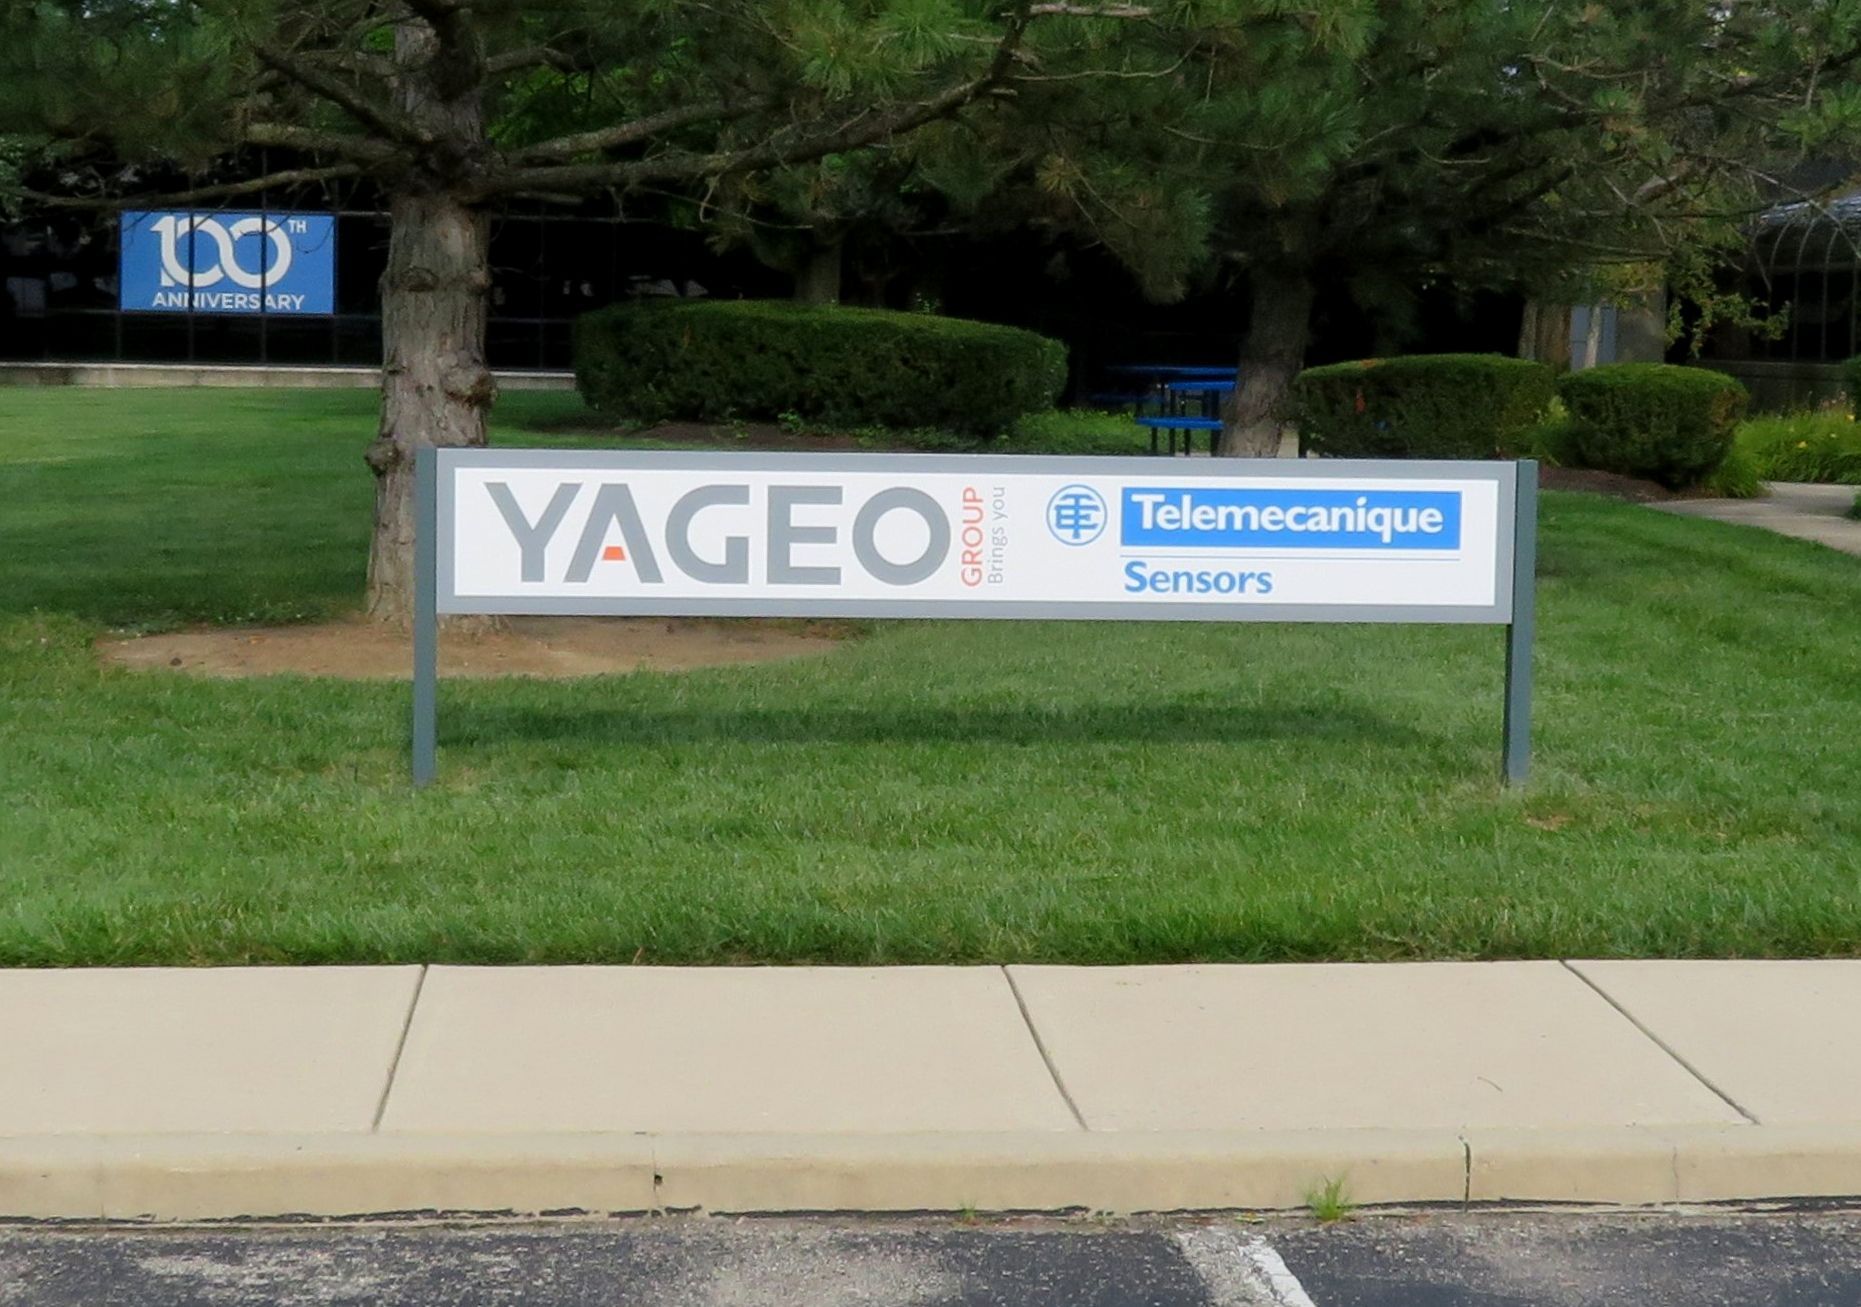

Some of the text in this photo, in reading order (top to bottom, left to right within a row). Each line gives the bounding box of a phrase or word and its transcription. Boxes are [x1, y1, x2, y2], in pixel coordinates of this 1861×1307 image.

[152, 291, 305, 310] ANNIVERSARY
[484, 481, 951, 586] YAGEO
[961, 487, 984, 587] GROUP
[987, 486, 1008, 584] Brings you
[1132, 494, 1443, 544] Telemecanique
[1124, 561, 1273, 594] Sensors
